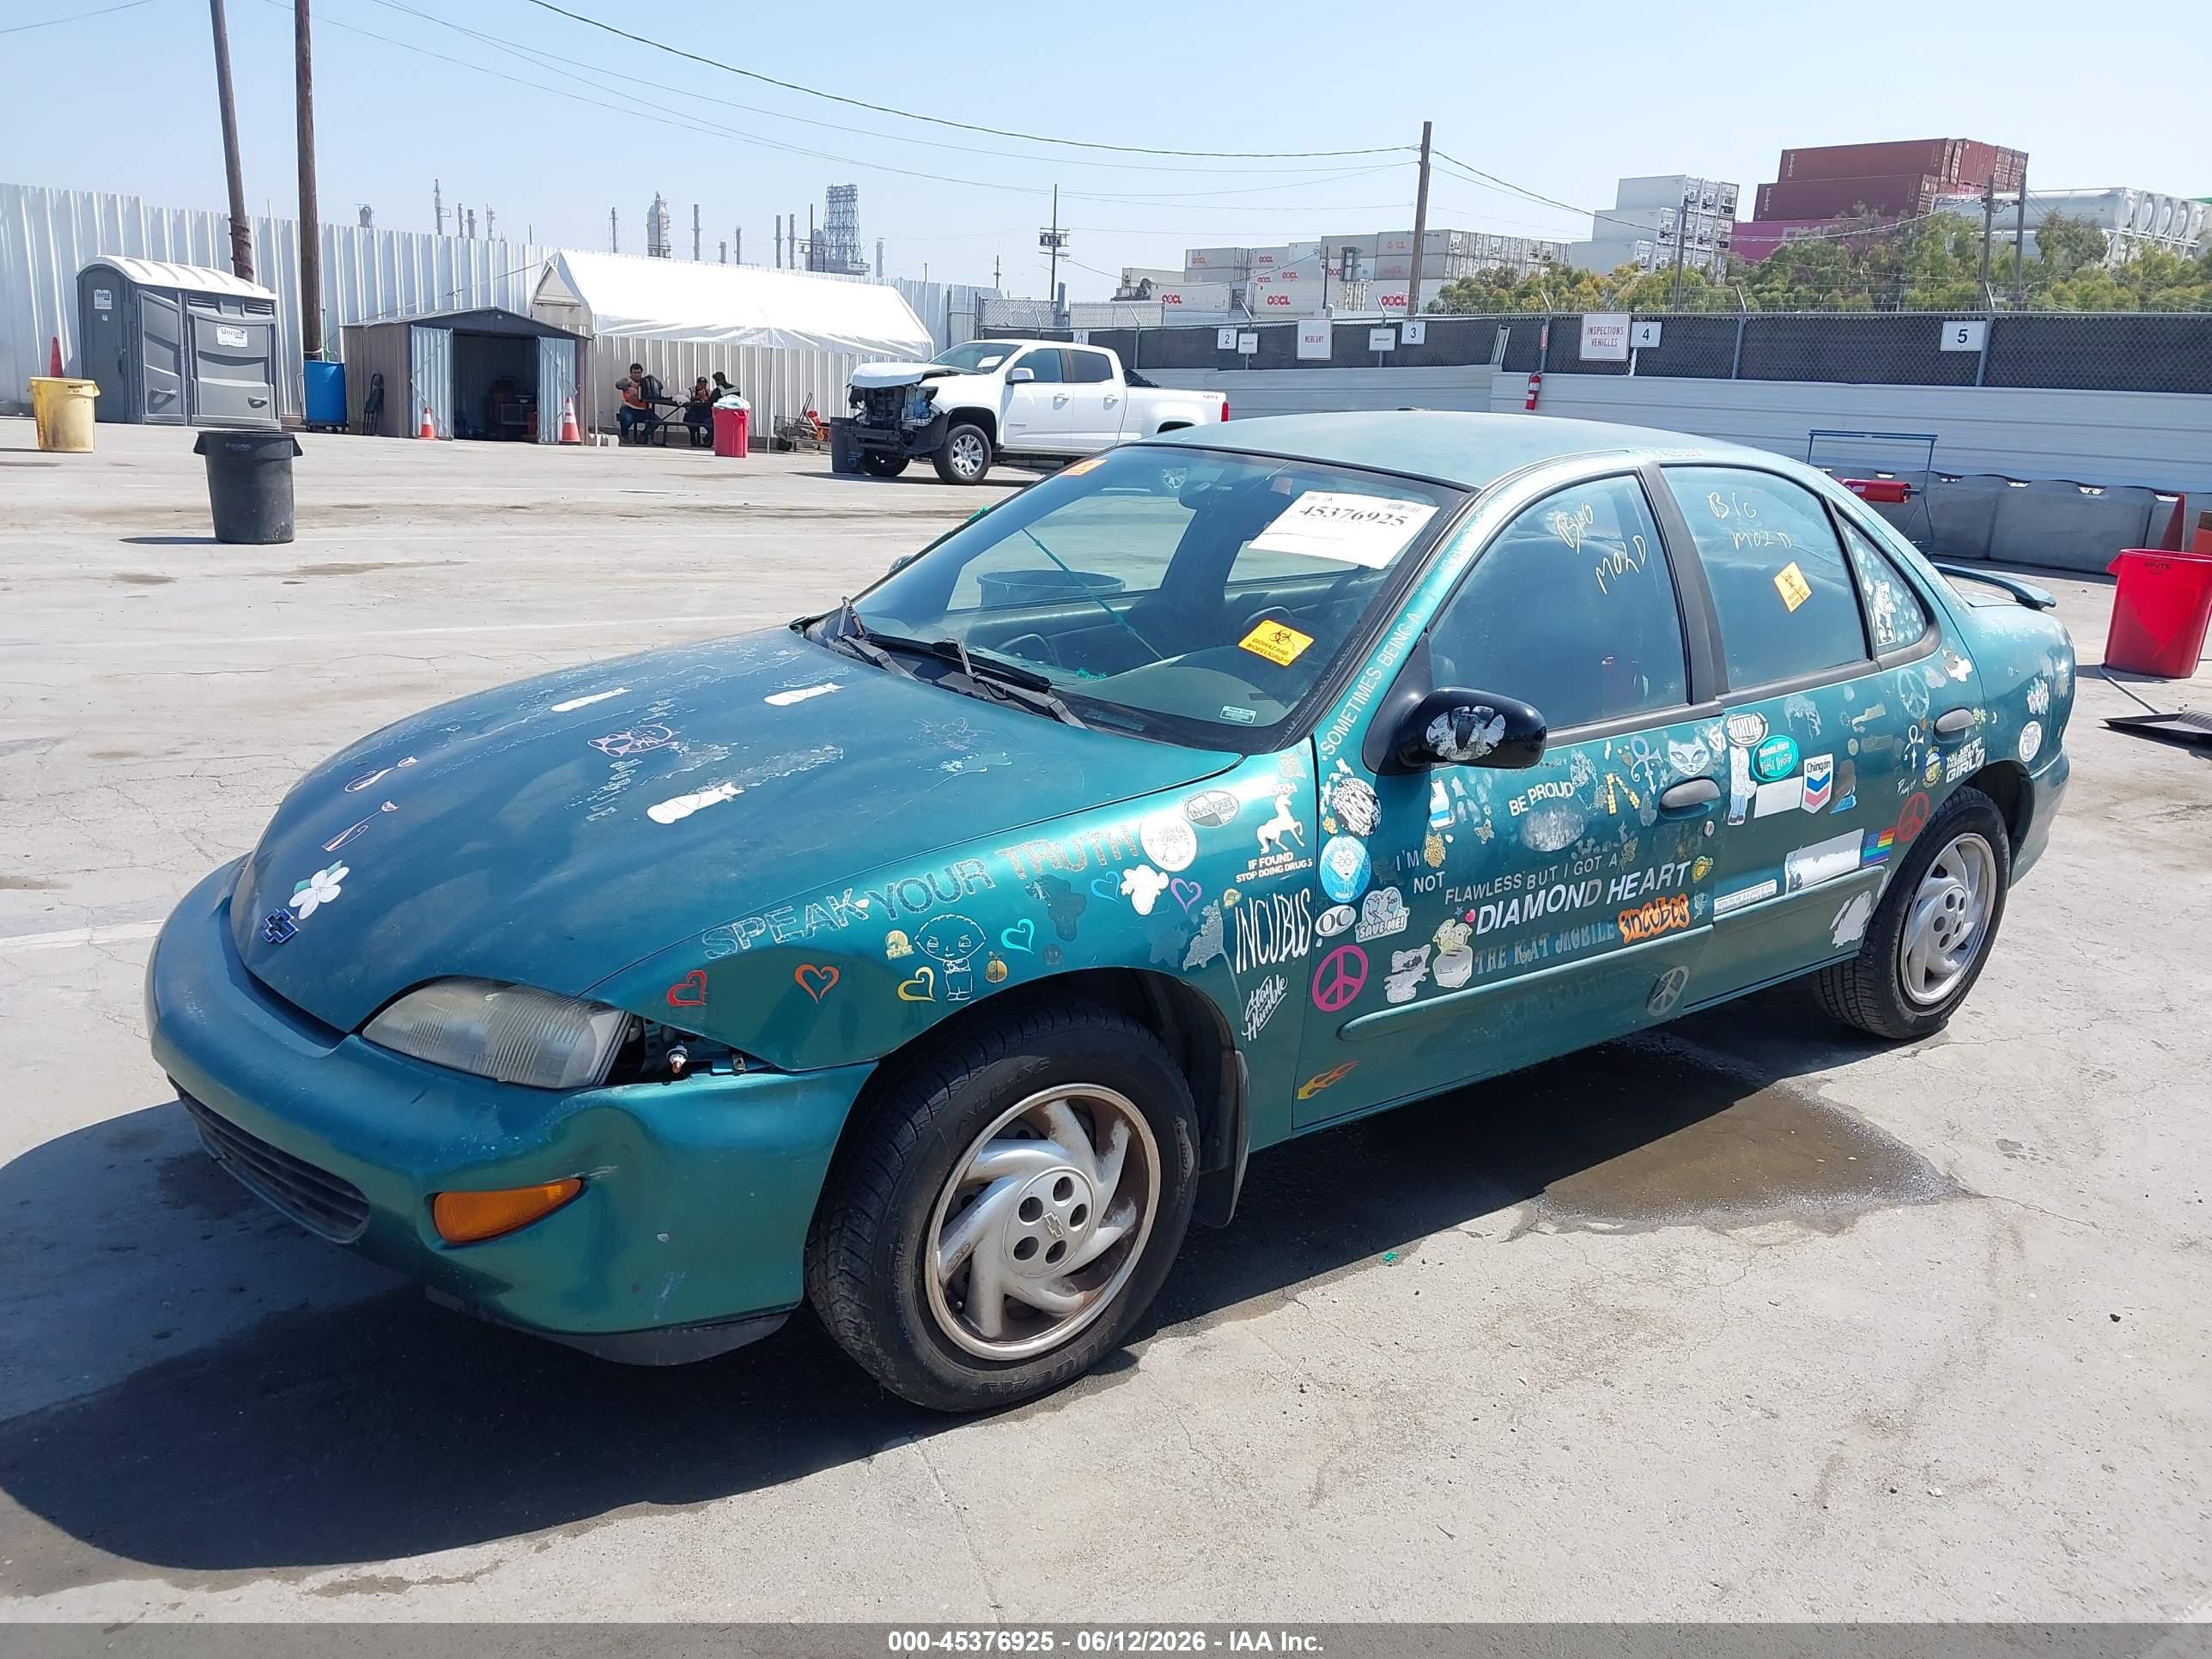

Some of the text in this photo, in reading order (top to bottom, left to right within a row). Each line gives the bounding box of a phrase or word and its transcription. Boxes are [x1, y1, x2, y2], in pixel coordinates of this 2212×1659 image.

[1162, 295, 1182, 304] OOCL
[1267, 295, 1291, 306] OOCL
[1382, 295, 1407, 307] OOCL
[220, 327, 246, 338] United
[1224, 333, 1231, 344] 2
[1304, 335, 1325, 343] MERCURY
[1410, 327, 1417, 339] 3
[1587, 325, 1625, 335] INSPECTIONS
[1642, 328, 1650, 341] 4
[1956, 329, 1968, 343] 5
[1590, 337, 1619, 348] VEHICLES
[1299, 505, 1410, 526] 45376925
[1731, 530, 1792, 550] MOLD
[1595, 534, 1647, 595] MOLD
[1252, 638, 1289, 657] BIOHAZARD
[1376, 623, 1413, 667] BEING
[1406, 611, 1423, 625] A
[1245, 643, 1284, 662] BIOPELIGRO
[1946, 758, 1977, 783] GIRL
[1509, 781, 1574, 817] BE PROUD
[1248, 852, 1294, 871] IF FOUND
[1395, 849, 1419, 872] I'M
[1236, 859, 1313, 884] STOP DOING DRUGS
[1444, 853, 1618, 906] FLAWLESS BUT I GOT A
[702, 823, 1139, 960] SPEAK YOUR TRUTH
[1413, 871, 1446, 894] NOT
[1476, 878, 1603, 935] DIAMOND
[1606, 860, 1691, 905] HEART
[1319, 908, 1352, 933] OC
[1359, 921, 1385, 939] SAVE
[1387, 915, 1406, 932] ME!
[1235, 887, 1312, 975] INCUBUS
[1474, 920, 1615, 975] THE KAT MOBILE
